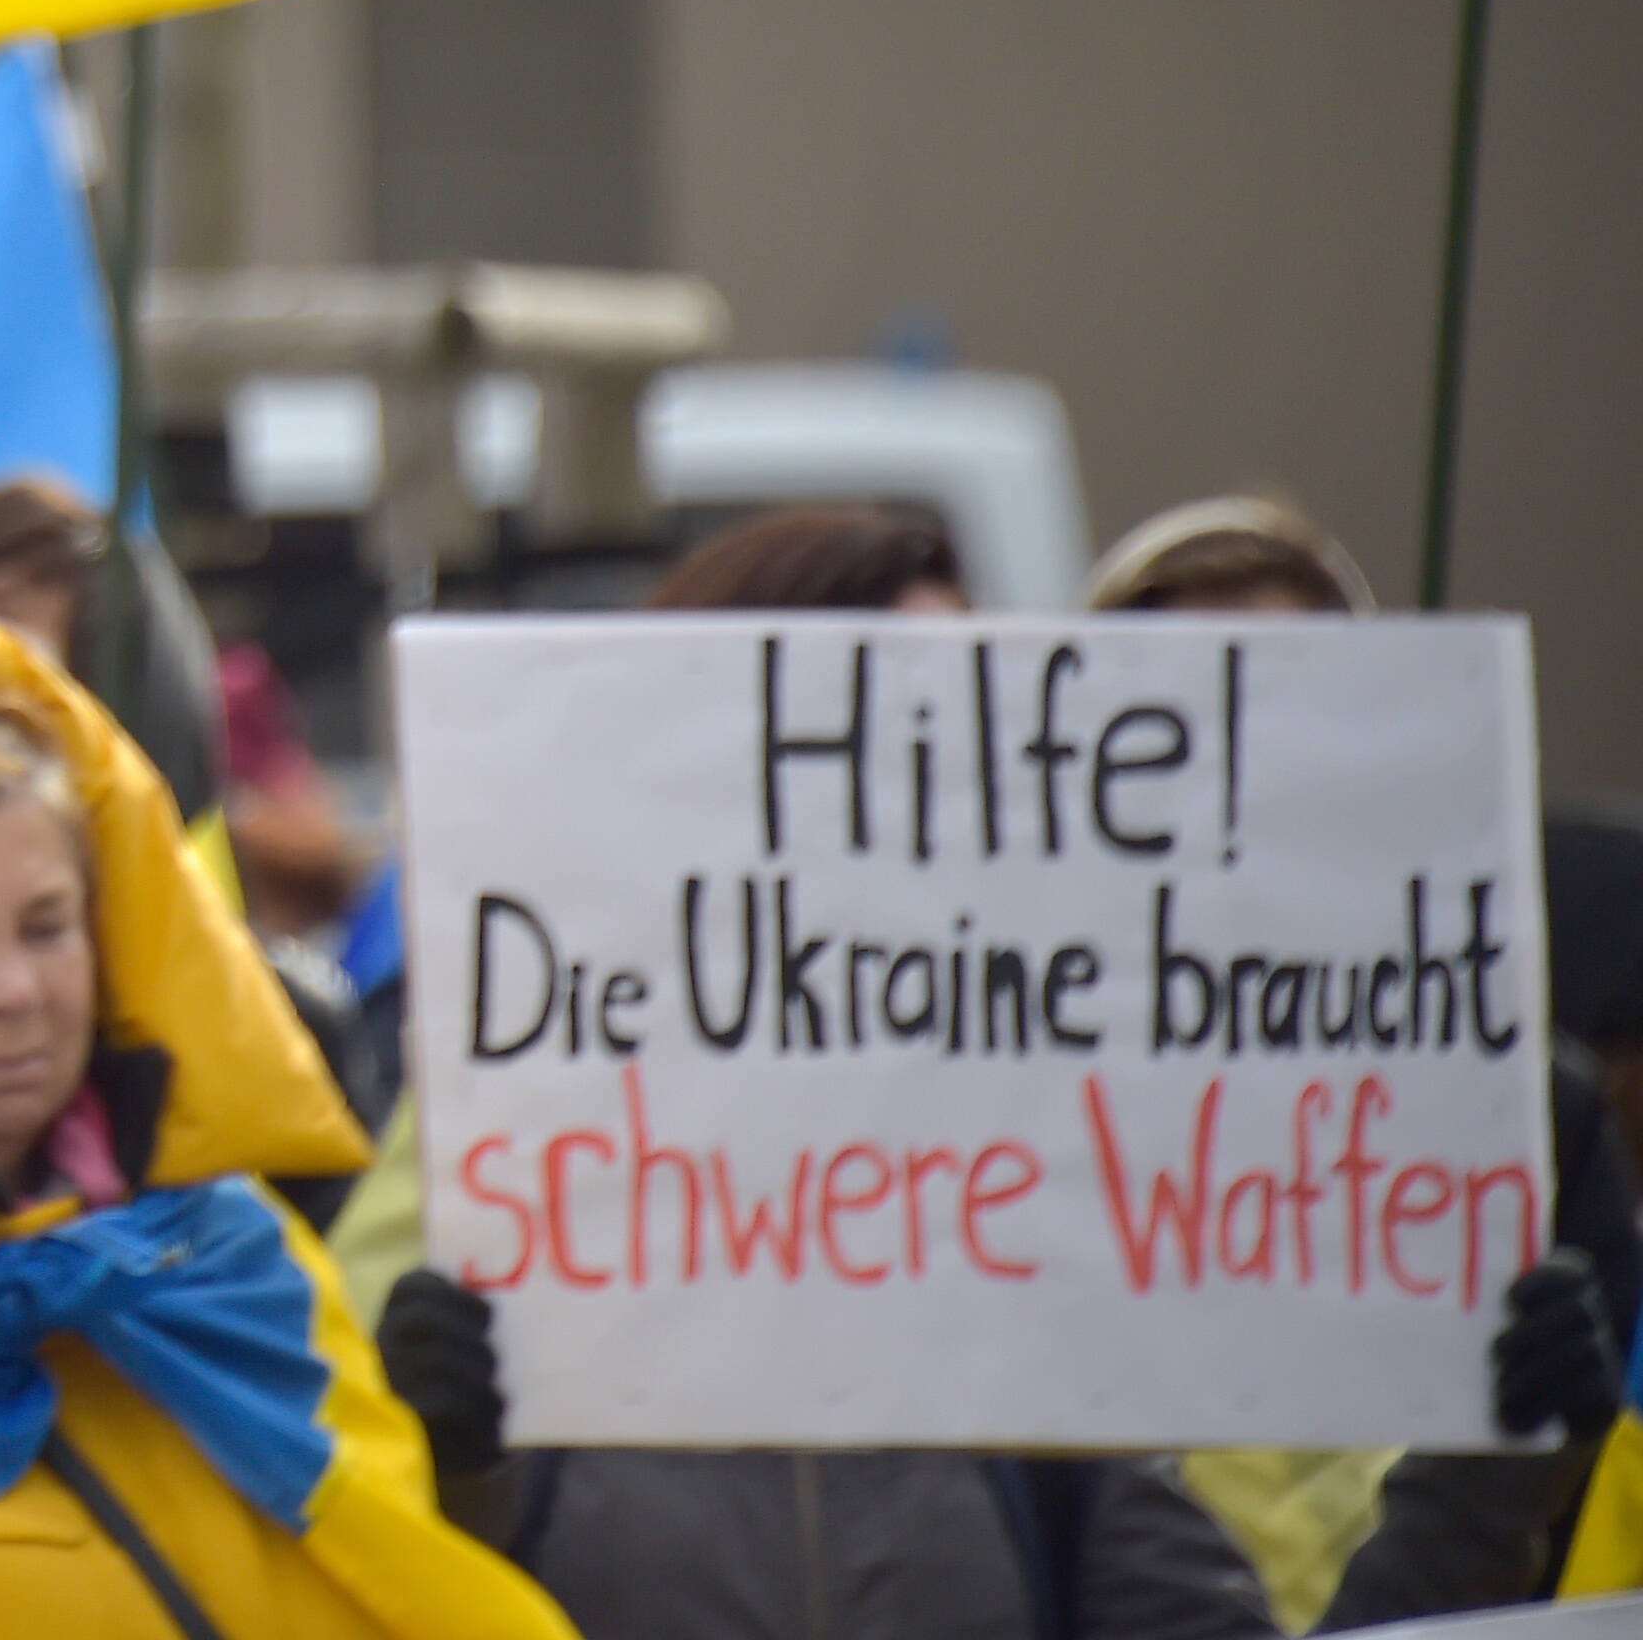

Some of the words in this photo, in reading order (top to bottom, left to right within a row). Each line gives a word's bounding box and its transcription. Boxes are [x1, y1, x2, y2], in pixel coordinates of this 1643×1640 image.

[760, 637, 1244, 864] Hilfe!
[469, 893, 651, 1059] Die
[682, 877, 1103, 1055] Ukraine
[1152, 876, 1519, 1057] braucht
[458, 1055, 1043, 1292] schwere
[1083, 1073, 1541, 1311] Waffen
